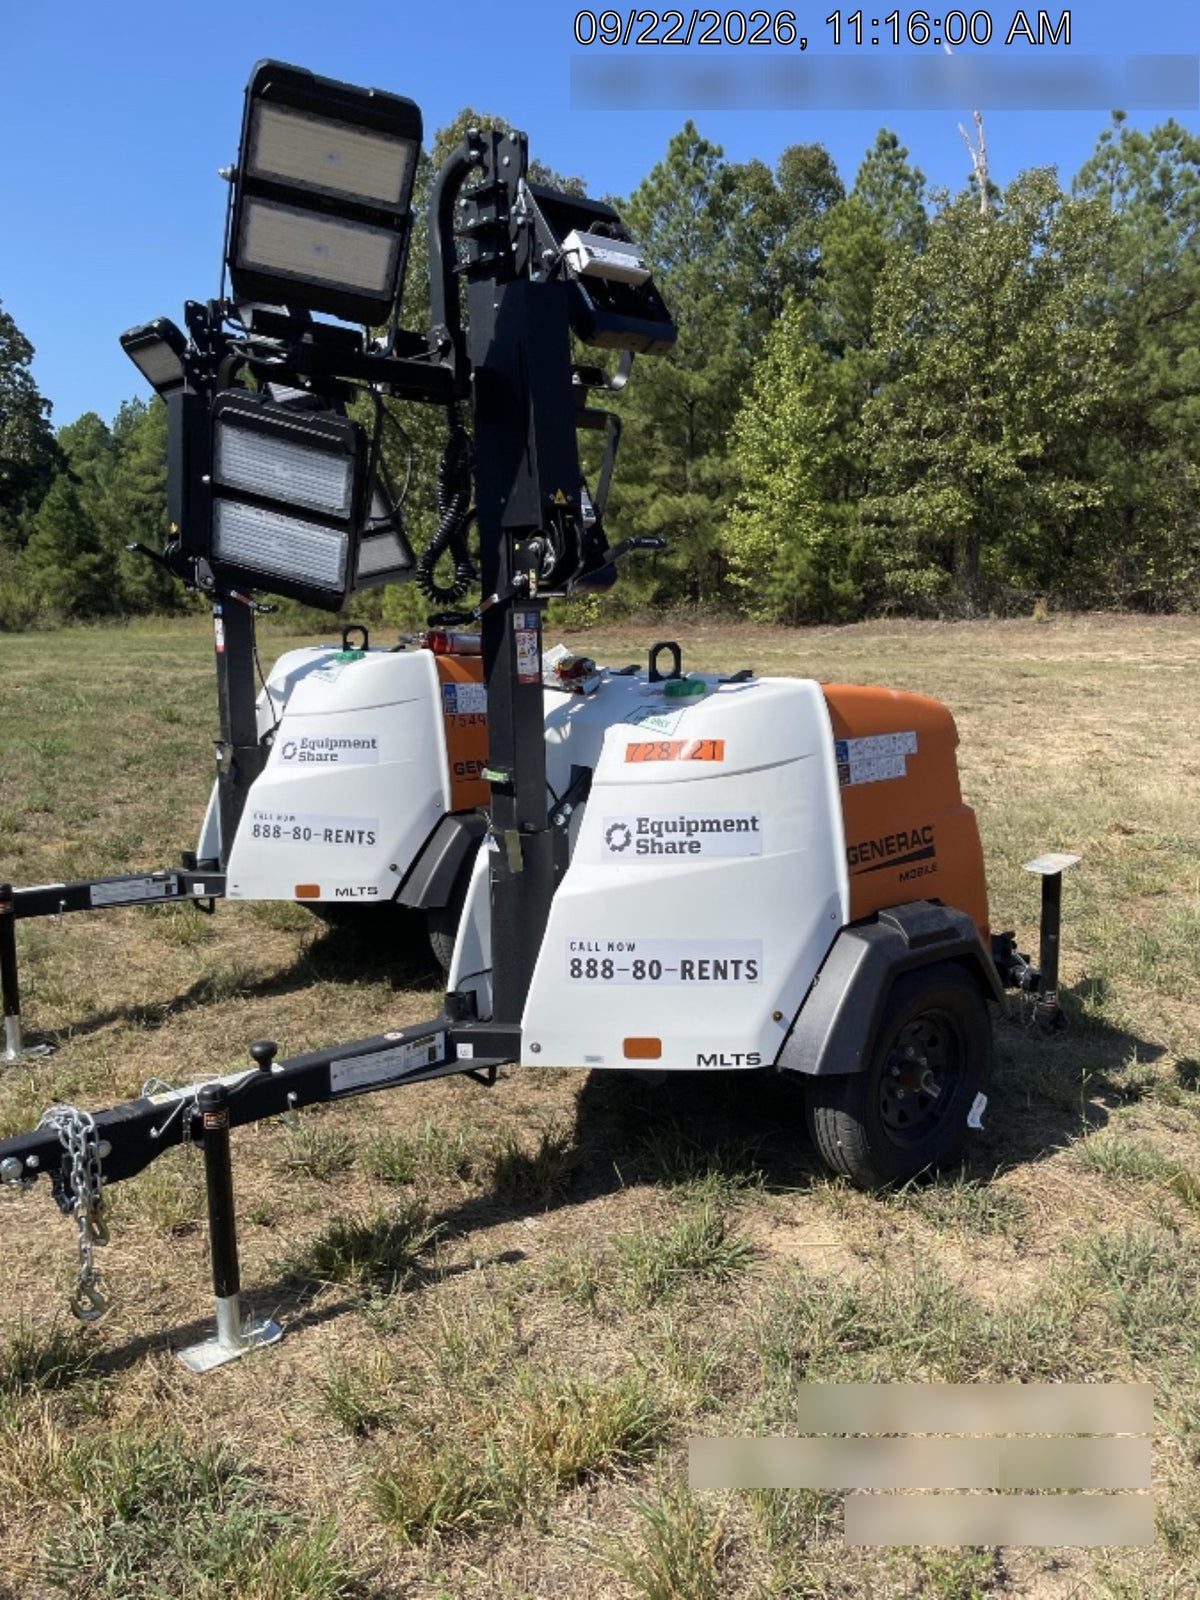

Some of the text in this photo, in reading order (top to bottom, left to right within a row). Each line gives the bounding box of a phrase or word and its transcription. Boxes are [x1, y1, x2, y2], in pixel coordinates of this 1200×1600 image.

[300, 737, 377, 751] Equipment
[298, 751, 338, 762] Share
[252, 823, 377, 846] 888-80-RENTS
[636, 815, 760, 838] Equipment
[636, 838, 702, 855] Share
[846, 825, 935, 866] GENERAC
[898, 862, 938, 882] MOBILE
[335, 886, 379, 897] MLTS
[570, 942, 636, 952] CALL NOW
[570, 958, 759, 981] 888-80-RENTS
[696, 1052, 762, 1067] MLTS
